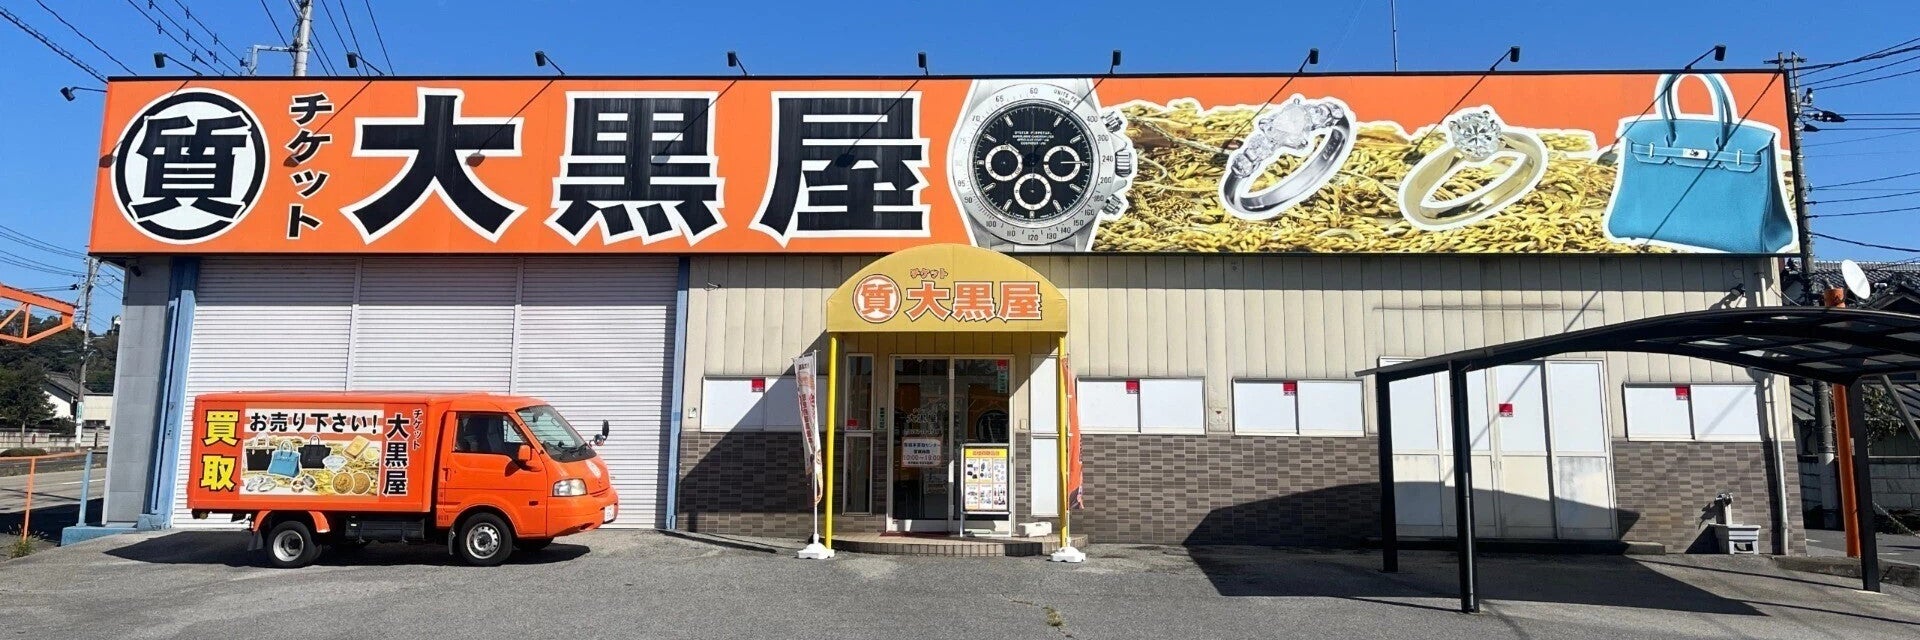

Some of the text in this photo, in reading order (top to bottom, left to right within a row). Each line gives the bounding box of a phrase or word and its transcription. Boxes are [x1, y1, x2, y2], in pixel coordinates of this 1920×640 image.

[129, 112, 252, 222] 質
[287, 92, 333, 240] チケット
[339, 86, 931, 248] 大黒屋
[1102, 155, 1114, 163] 240
[1073, 219, 1084, 227] 150
[859, 282, 896, 317] 質
[905, 280, 1042, 322] 大黒屋
[250, 412, 378, 434] お売り下さい！
[412, 409, 423, 450] チケット
[200, 409, 240, 492] 買取
[383, 413, 411, 496] 大黒屋
